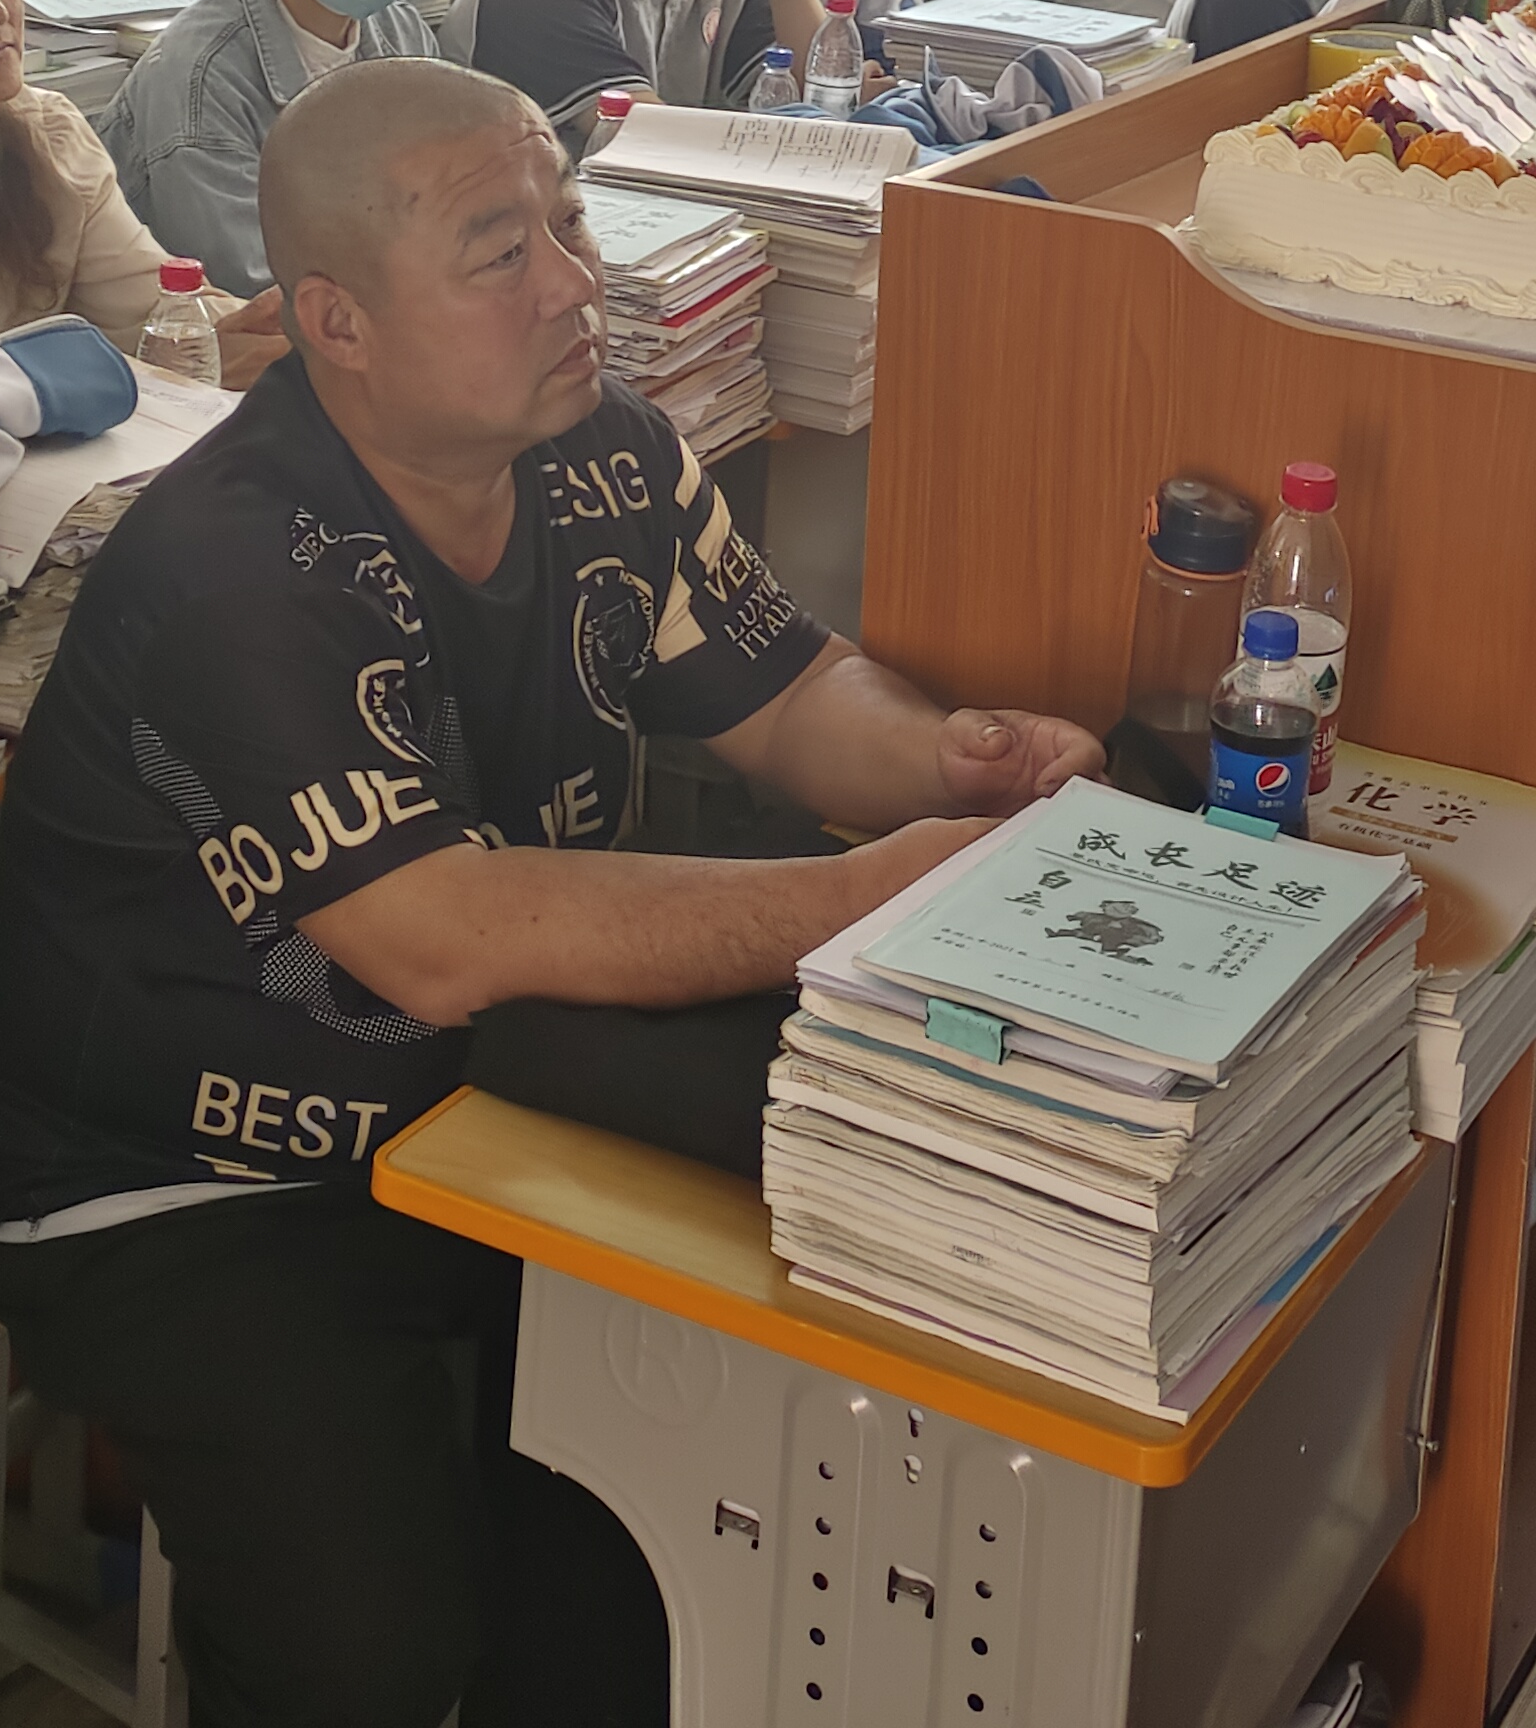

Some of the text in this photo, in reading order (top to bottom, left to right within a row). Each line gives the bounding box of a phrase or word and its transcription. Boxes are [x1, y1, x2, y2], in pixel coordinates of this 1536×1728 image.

[1347, 781, 1478, 826] 化学
[1338, 822, 1433, 851] 有机化学基础
[1005, 870, 1072, 908] 自立
[1076, 828, 1328, 909] 成长足迹
[191, 1071, 388, 1161] BEST
